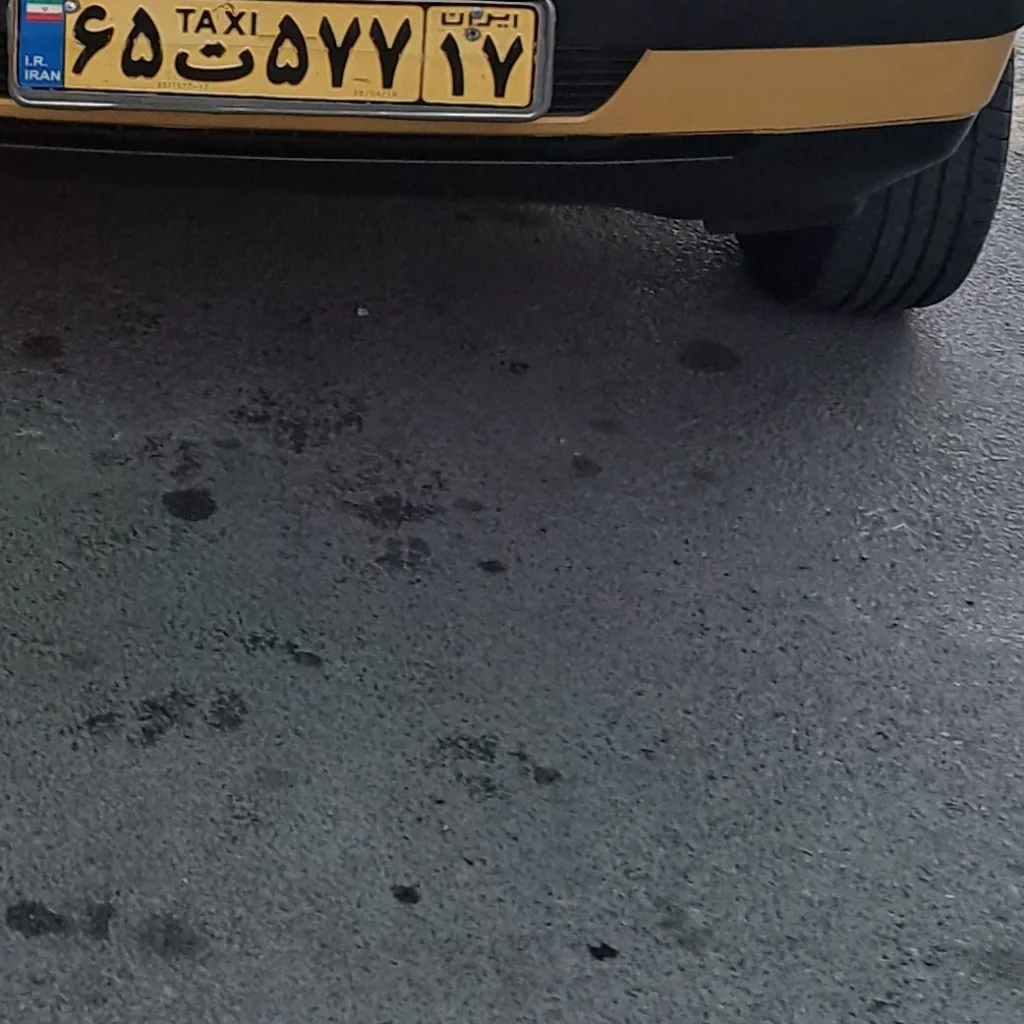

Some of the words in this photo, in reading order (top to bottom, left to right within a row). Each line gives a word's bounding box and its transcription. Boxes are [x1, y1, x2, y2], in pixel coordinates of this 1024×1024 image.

[175, 8, 257, 35] TAXI
[440, 12, 518, 27] ایران
[25, 55, 49, 68] I.R.
[440, 33, 524, 97] ۱۷
[24, 68, 62, 82] IRAN
